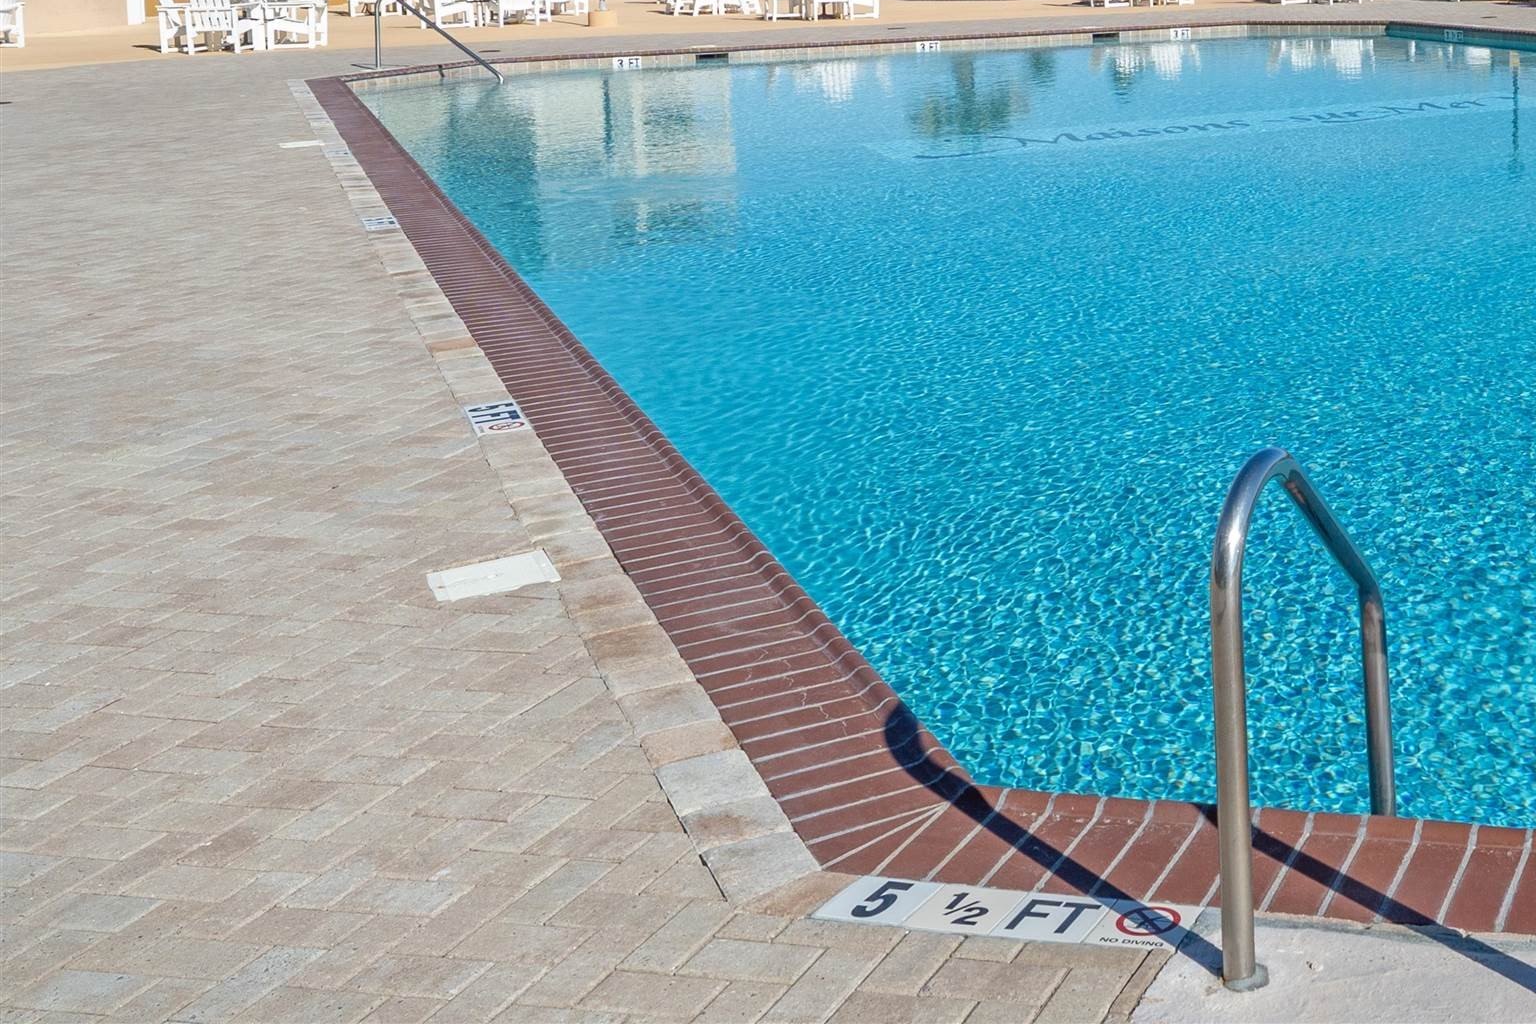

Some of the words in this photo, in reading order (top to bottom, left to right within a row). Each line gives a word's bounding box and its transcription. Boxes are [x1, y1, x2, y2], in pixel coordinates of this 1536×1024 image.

[628, 57, 640, 68] FT
[850, 880, 916, 919] 5
[1004, 899, 1102, 934] FT
[1122, 938, 1165, 947] DIVING
